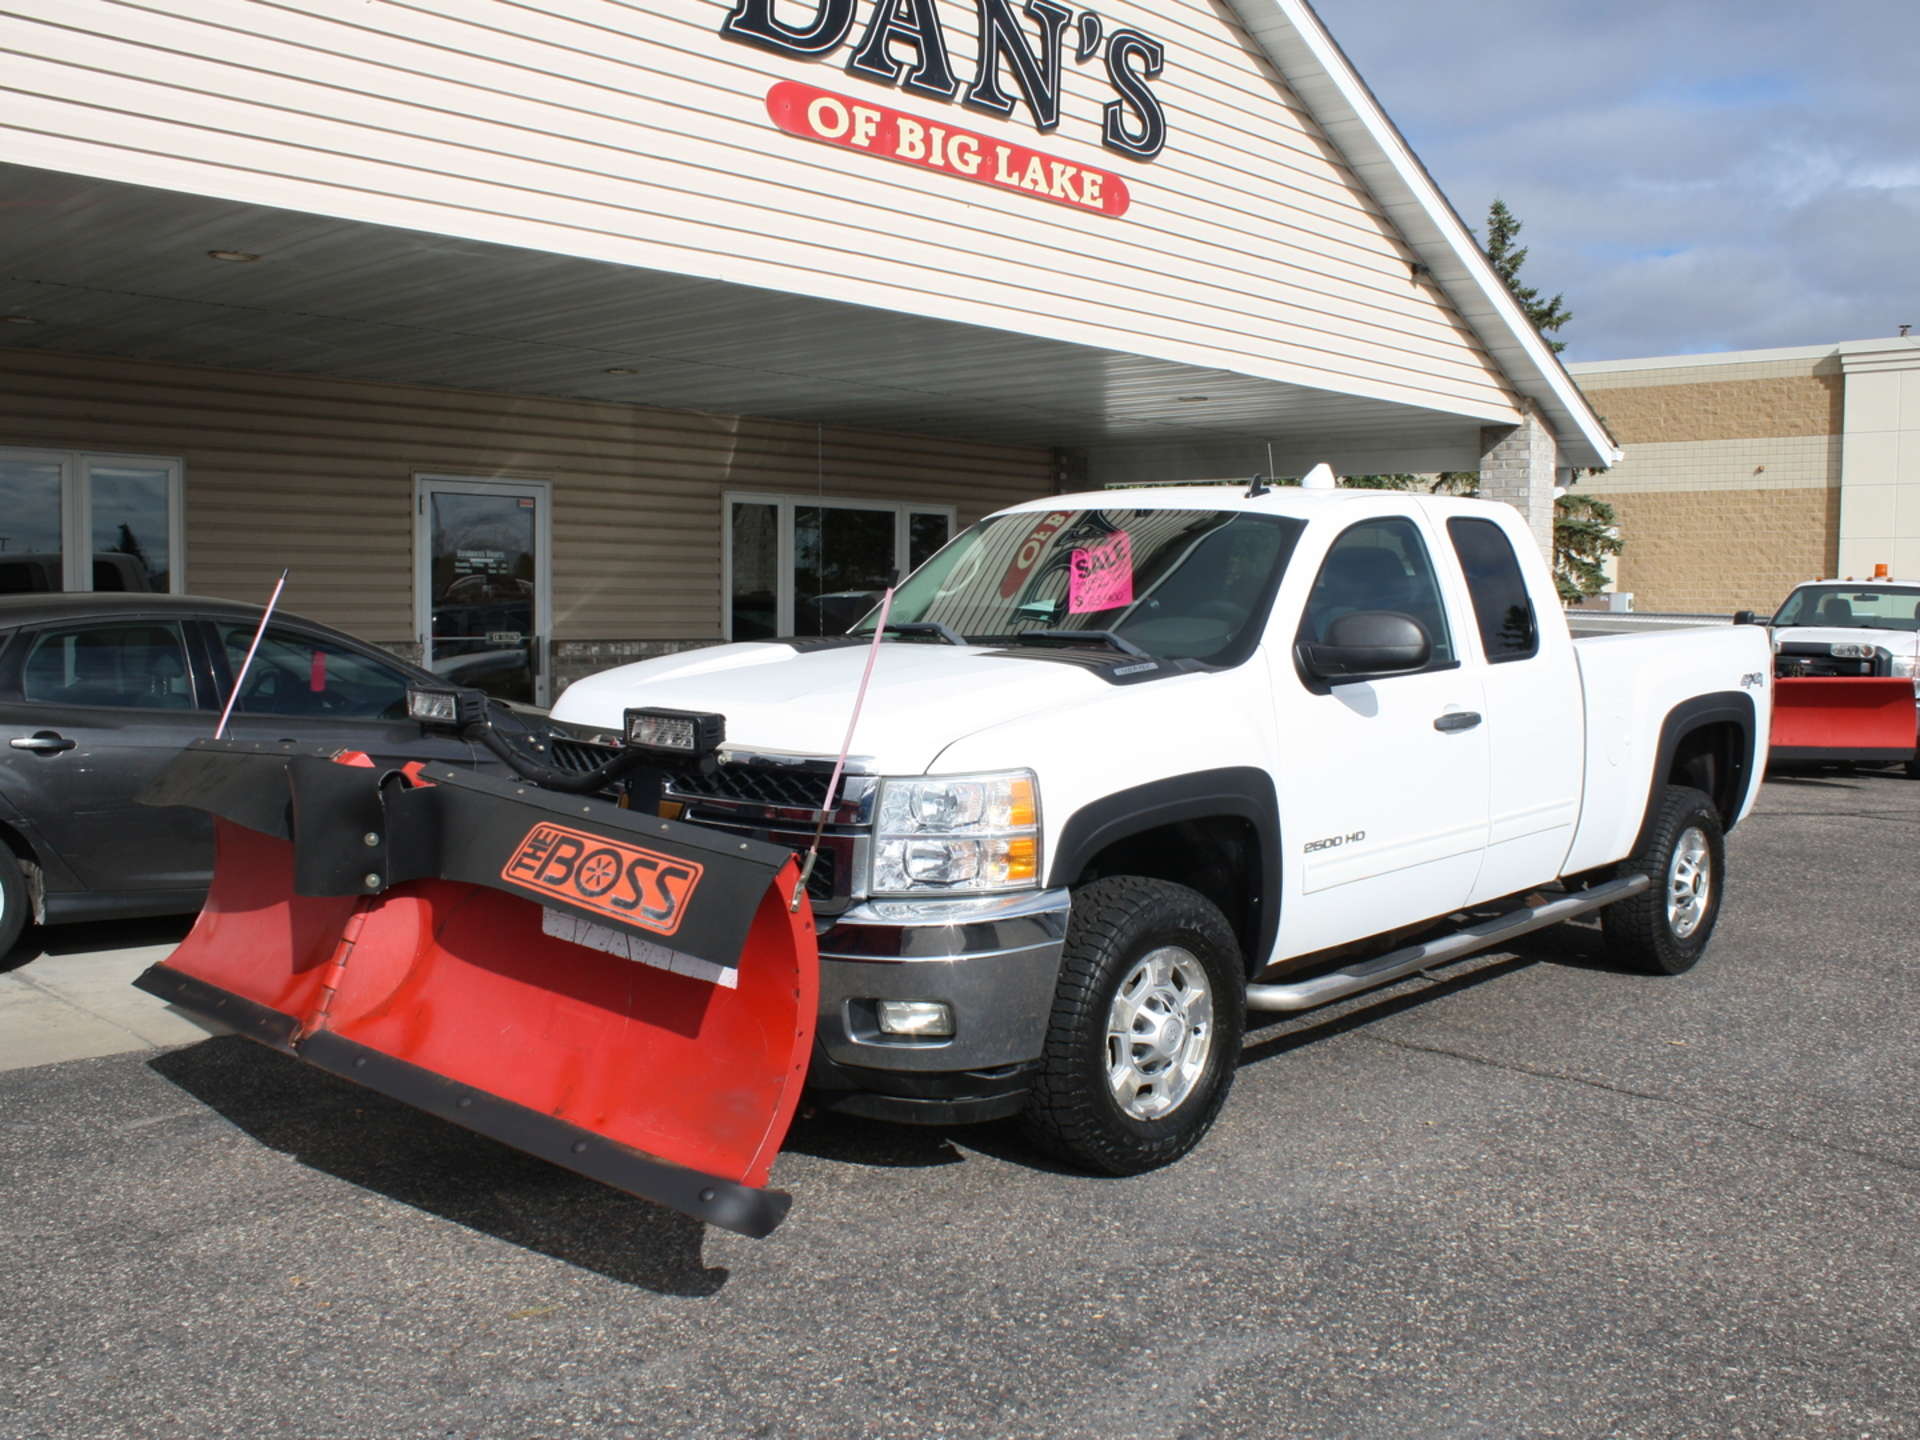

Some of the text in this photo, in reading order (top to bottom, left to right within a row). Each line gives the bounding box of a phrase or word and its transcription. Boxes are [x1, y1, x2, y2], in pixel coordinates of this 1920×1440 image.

[807, 96, 1104, 209] OF BIG LAKE
[1075, 540, 1128, 579] SALE
[1304, 830, 1366, 853] 2500 HD
[511, 829, 690, 920] THE BOSS
